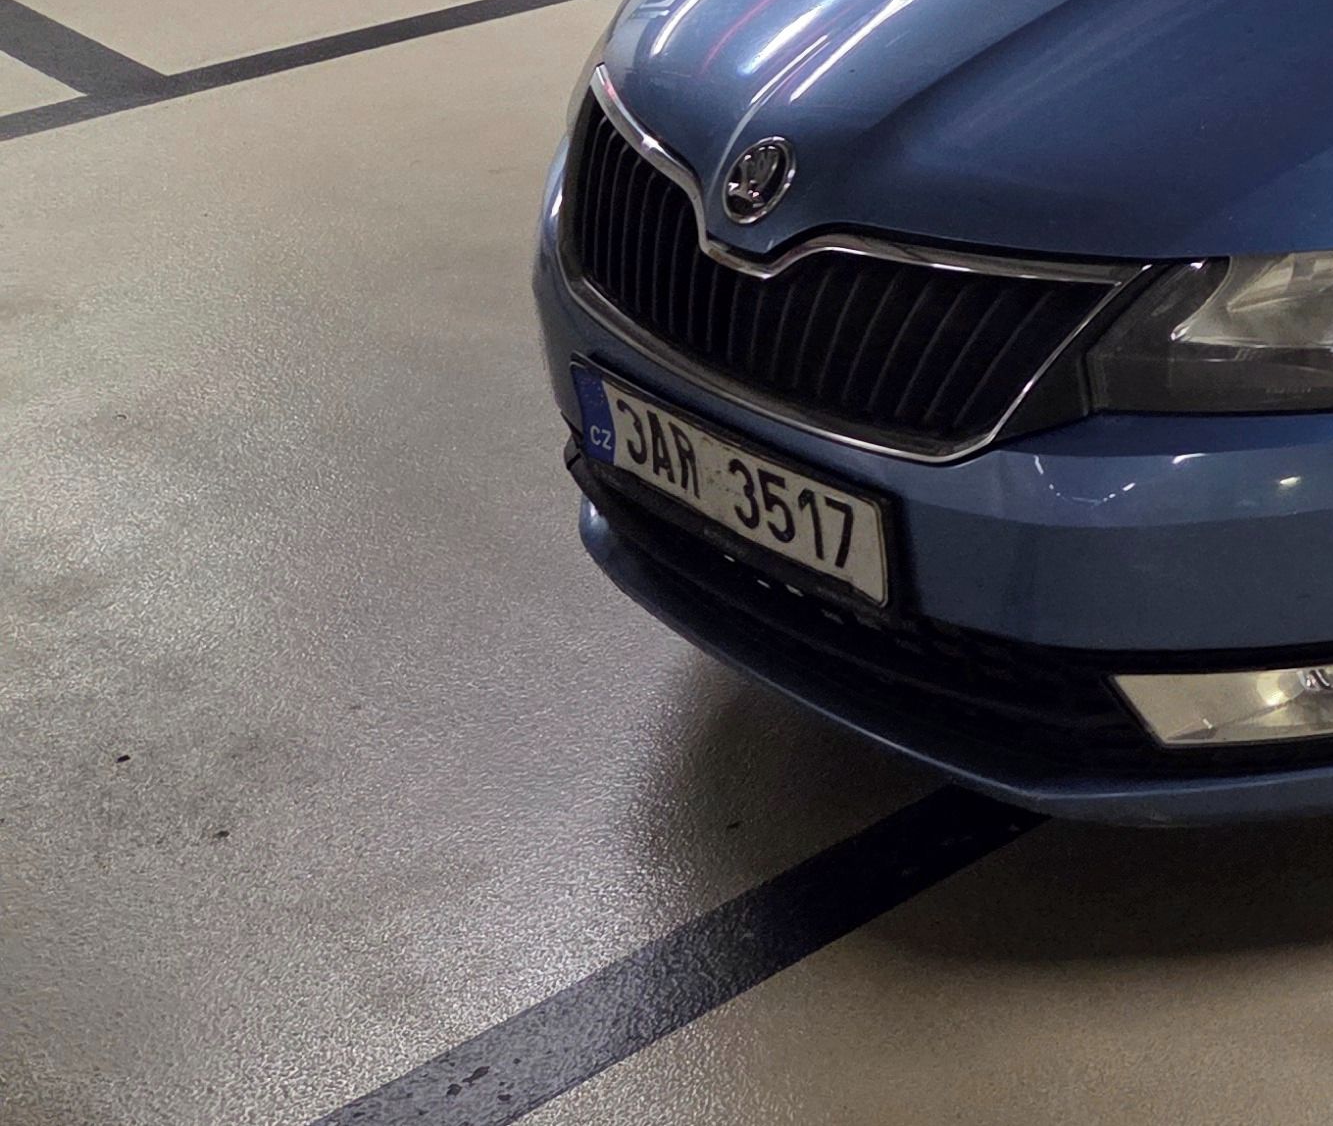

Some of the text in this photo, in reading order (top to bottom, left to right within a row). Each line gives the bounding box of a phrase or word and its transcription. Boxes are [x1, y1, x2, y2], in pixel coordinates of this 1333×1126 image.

[589, 425, 613, 451] CZ
[616, 399, 854, 568] 3AR 3517
